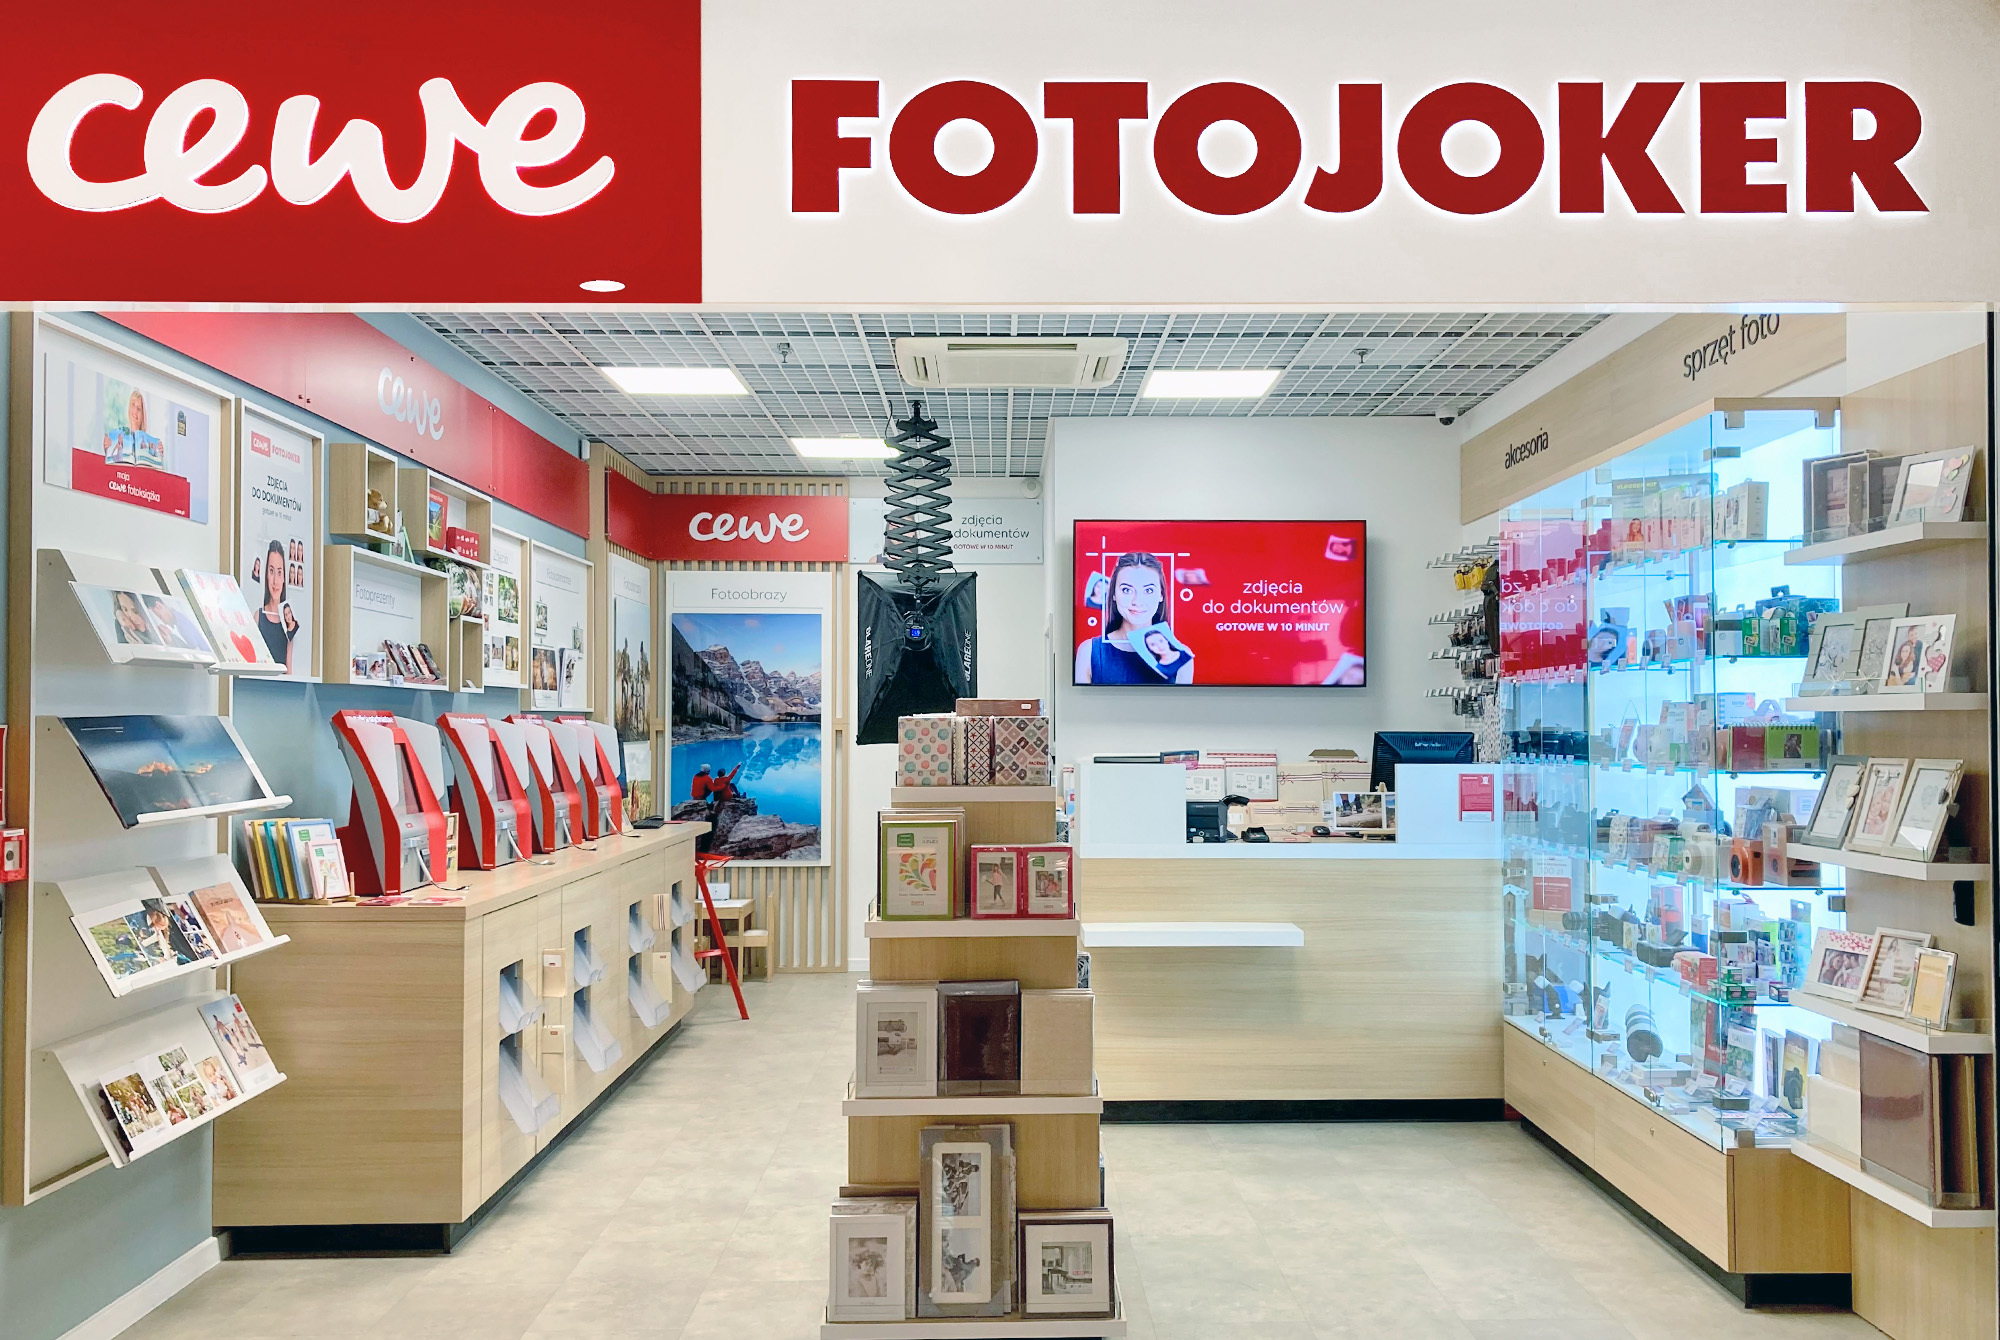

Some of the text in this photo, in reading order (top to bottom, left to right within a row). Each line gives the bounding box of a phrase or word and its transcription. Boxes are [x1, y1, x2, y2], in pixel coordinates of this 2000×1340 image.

[27, 73, 614, 223] cewe
[791, 80, 1930, 215] FOTOJOKER
[1683, 313, 1780, 381] sprzęt foto
[378, 366, 444, 440] cewe
[1504, 428, 1549, 470] akcesoria
[116, 471, 130, 481] moja
[267, 475, 288, 492] ZDJĘCIA
[108, 481, 160, 502] cewe fotoksiążka
[252, 486, 302, 512] DO DOKUMENTÓW
[689, 511, 809, 544] cewe
[961, 515, 1003, 527] zdjęcia
[953, 527, 1030, 539] dokumentów
[356, 584, 396, 609] Fotoprezenty
[711, 587, 787, 602] Fotoobrazy
[1243, 580, 1303, 595] zdjęcia
[1202, 598, 1344, 614] do dokumentów
[1216, 622, 1330, 632] GOTOWE W 10 MINUT
